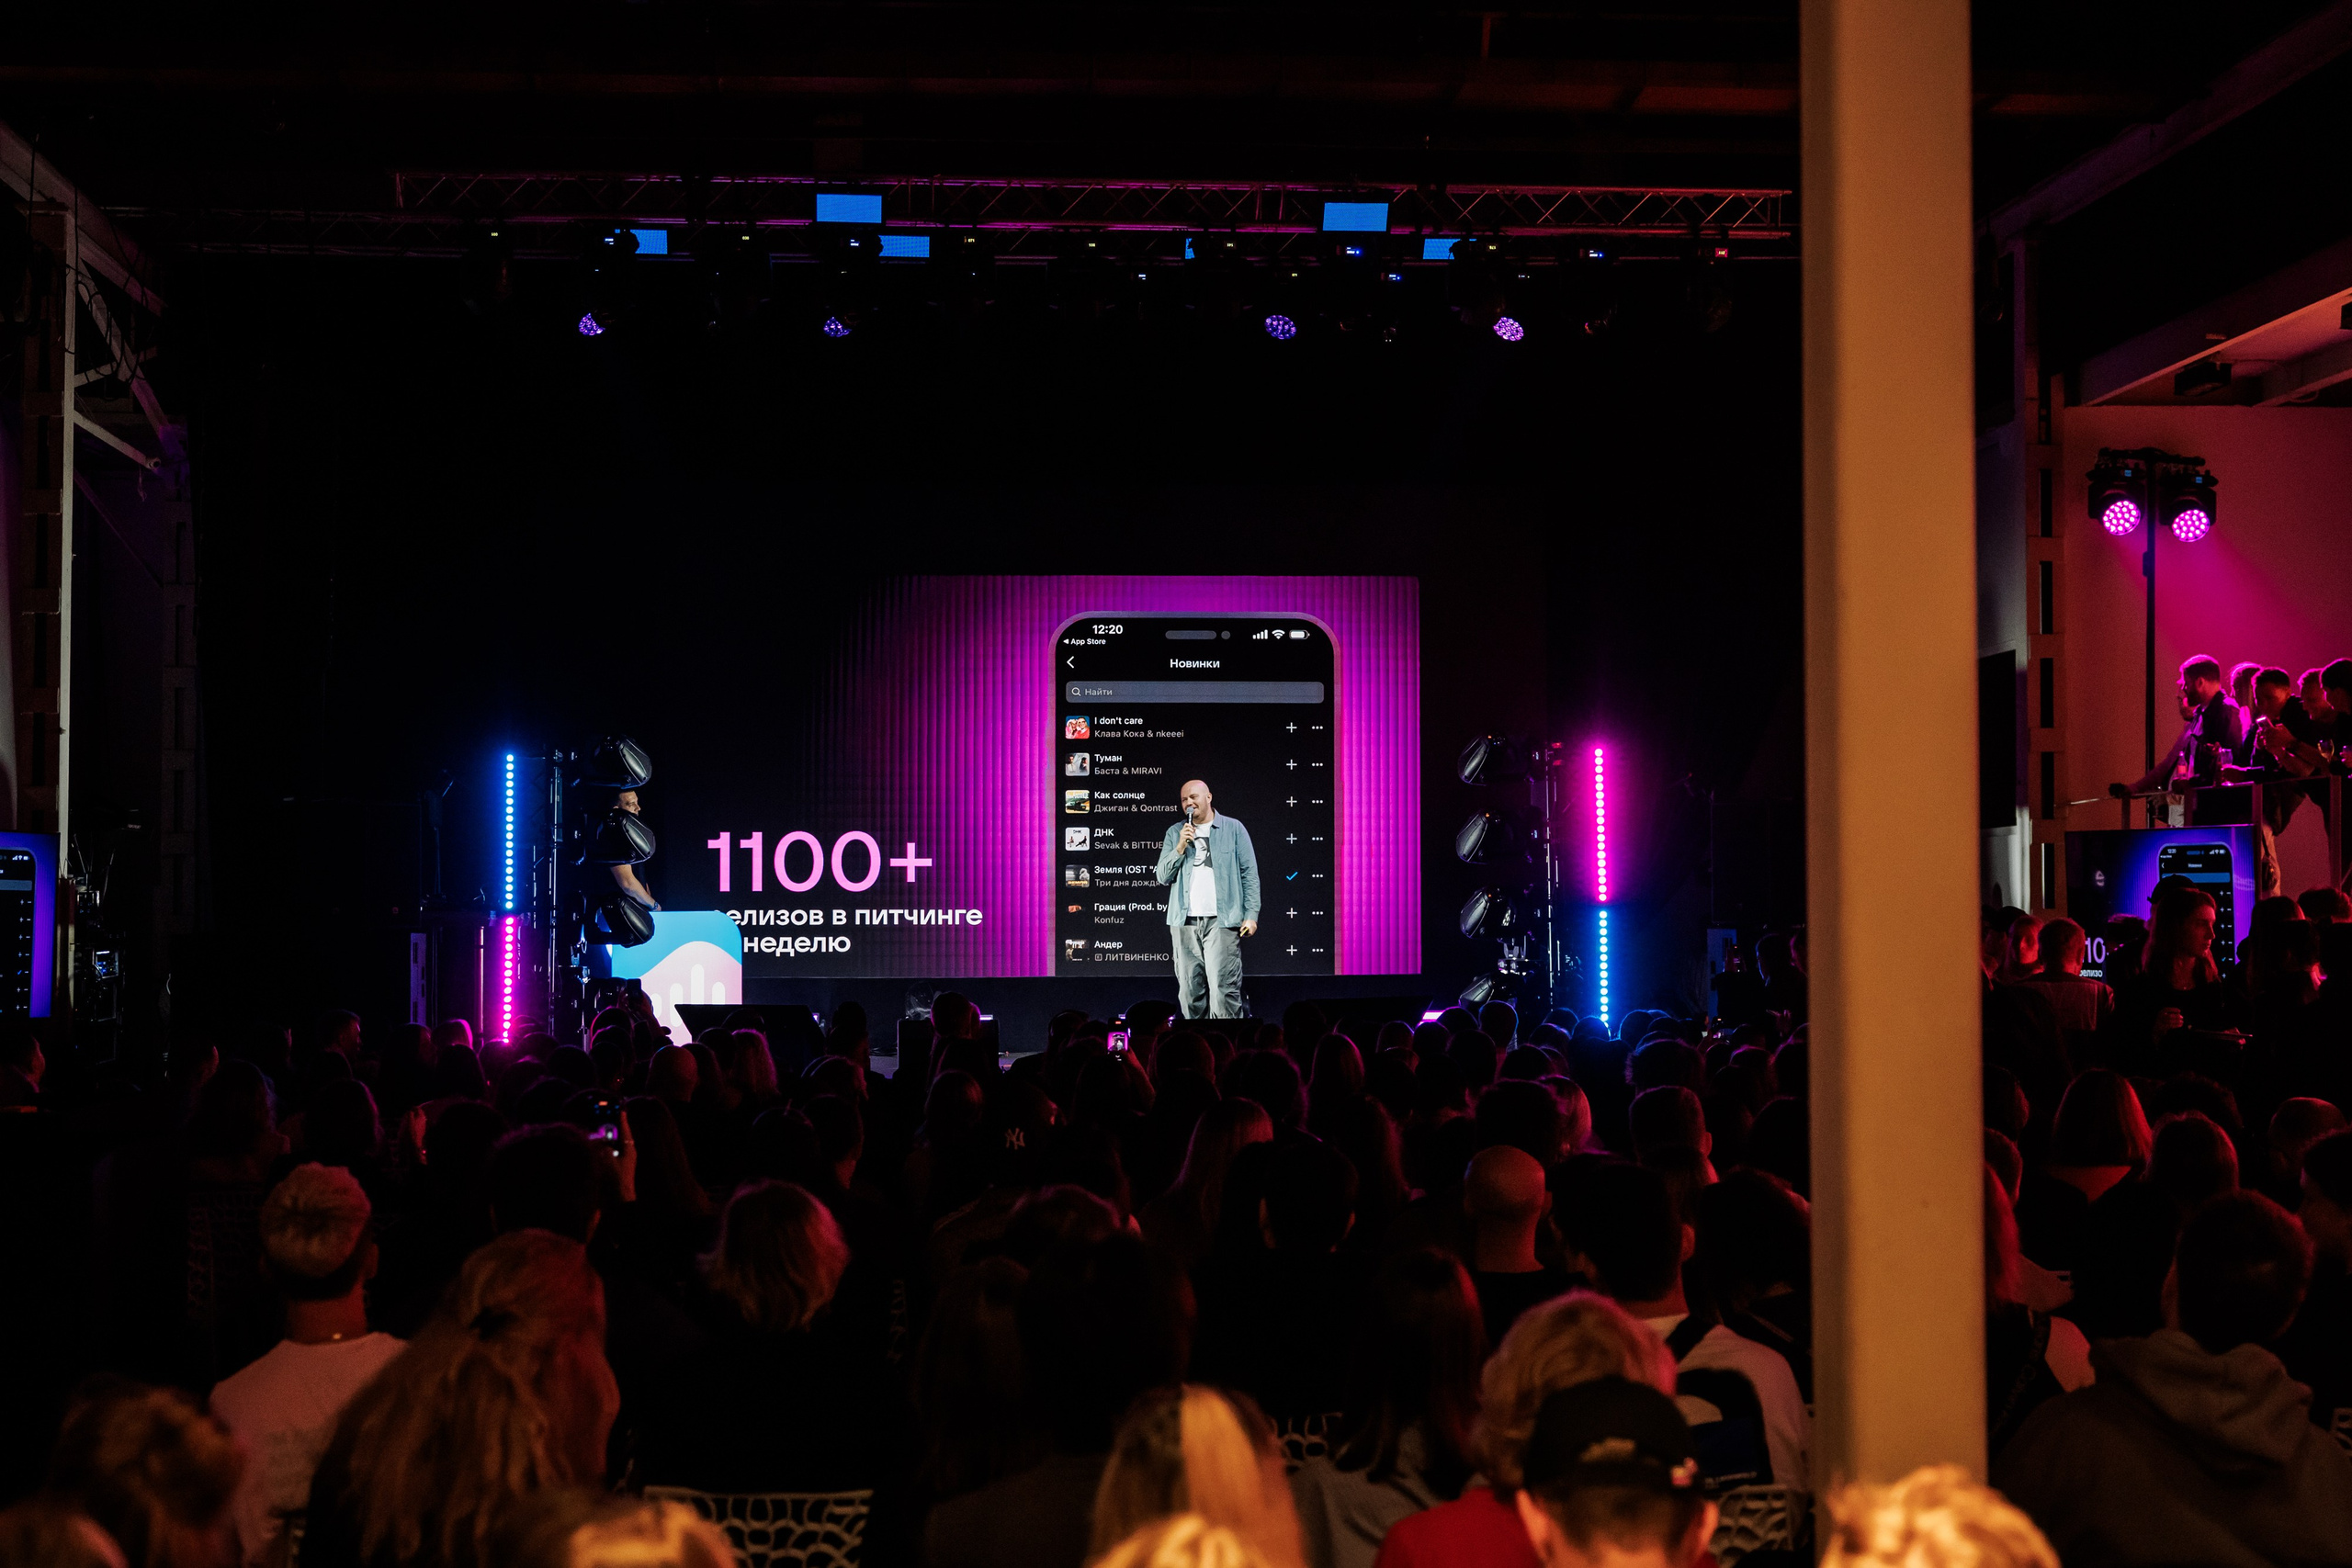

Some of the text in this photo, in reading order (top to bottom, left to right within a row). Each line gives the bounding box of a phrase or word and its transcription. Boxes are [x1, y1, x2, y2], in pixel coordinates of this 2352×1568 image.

[1092, 624, 1124, 635] 12:20
[1070, 637, 1086, 646] App
[1170, 658, 1220, 669] Новинки
[1084, 687, 1113, 696] Найти
[1099, 716, 1123, 725] don't
[1094, 729, 1184, 738] Клава Кока & nkeeei
[1093, 753, 1123, 763] Туман
[1094, 767, 1120, 775] Баста
[1122, 767, 1129, 775] &
[1094, 791, 1111, 799] Как
[1112, 792, 1146, 800] солнце
[1093, 804, 1178, 813] Джиган & Qontrast
[1093, 828, 1114, 838] ДНК
[1094, 841, 1164, 850] Sevak & BITTUE
[707, 830, 933, 893] 1100+
[1094, 865, 1123, 874] Земля
[1125, 865, 1148, 875] (OST
[1094, 878, 1112, 888] Три
[1113, 880, 1130, 888] дня
[1131, 880, 1160, 888] дождя
[1094, 902, 1168, 912] Грация (Prod. by
[714, 907, 983, 926] елизов в питчинге
[1094, 916, 1125, 924] Konfuz
[743, 936, 852, 957] неделю
[1093, 940, 1123, 950] Андер
[1104, 953, 1170, 962] ЛИТВИНЕНКО
